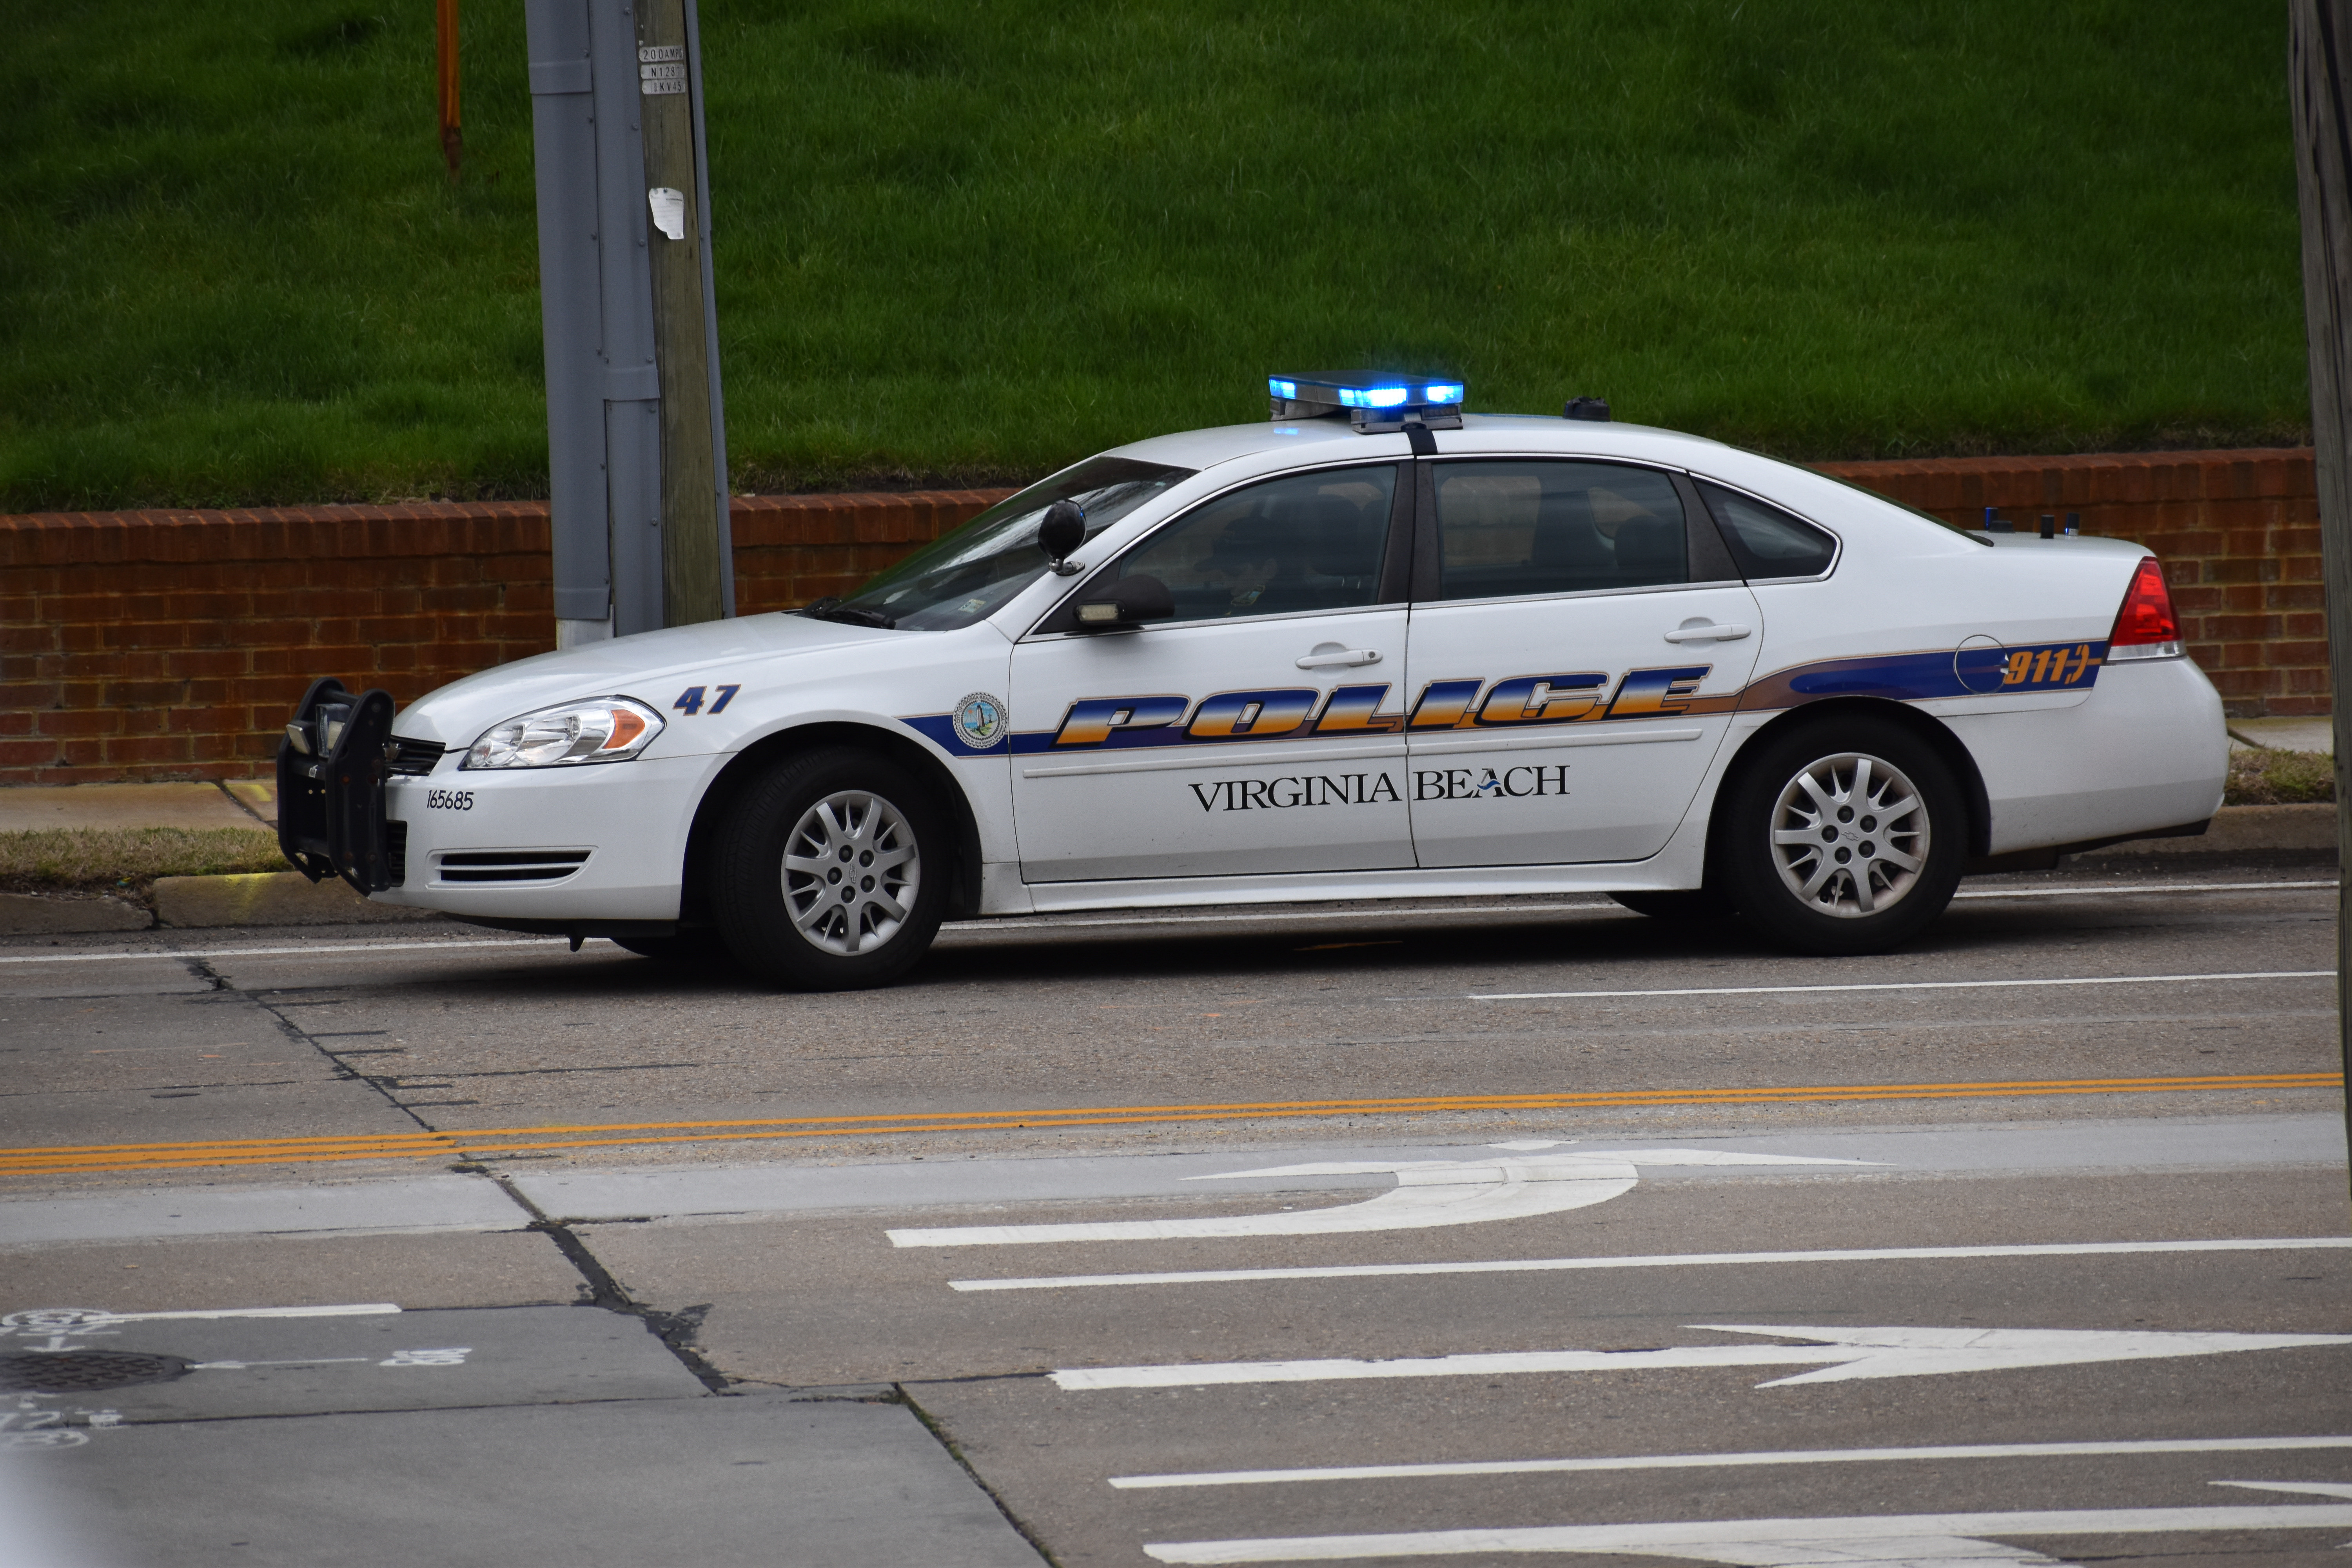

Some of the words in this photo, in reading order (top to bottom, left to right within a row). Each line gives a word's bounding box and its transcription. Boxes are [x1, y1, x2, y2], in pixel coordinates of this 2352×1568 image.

[2003, 648, 2070, 684] 911
[672, 684, 741, 716] 47
[1049, 665, 1711, 748] POLICE
[426, 789, 474, 811] 165685
[1188, 772, 1402, 812] VIRGINIA
[1413, 765, 1570, 800] BEACH
